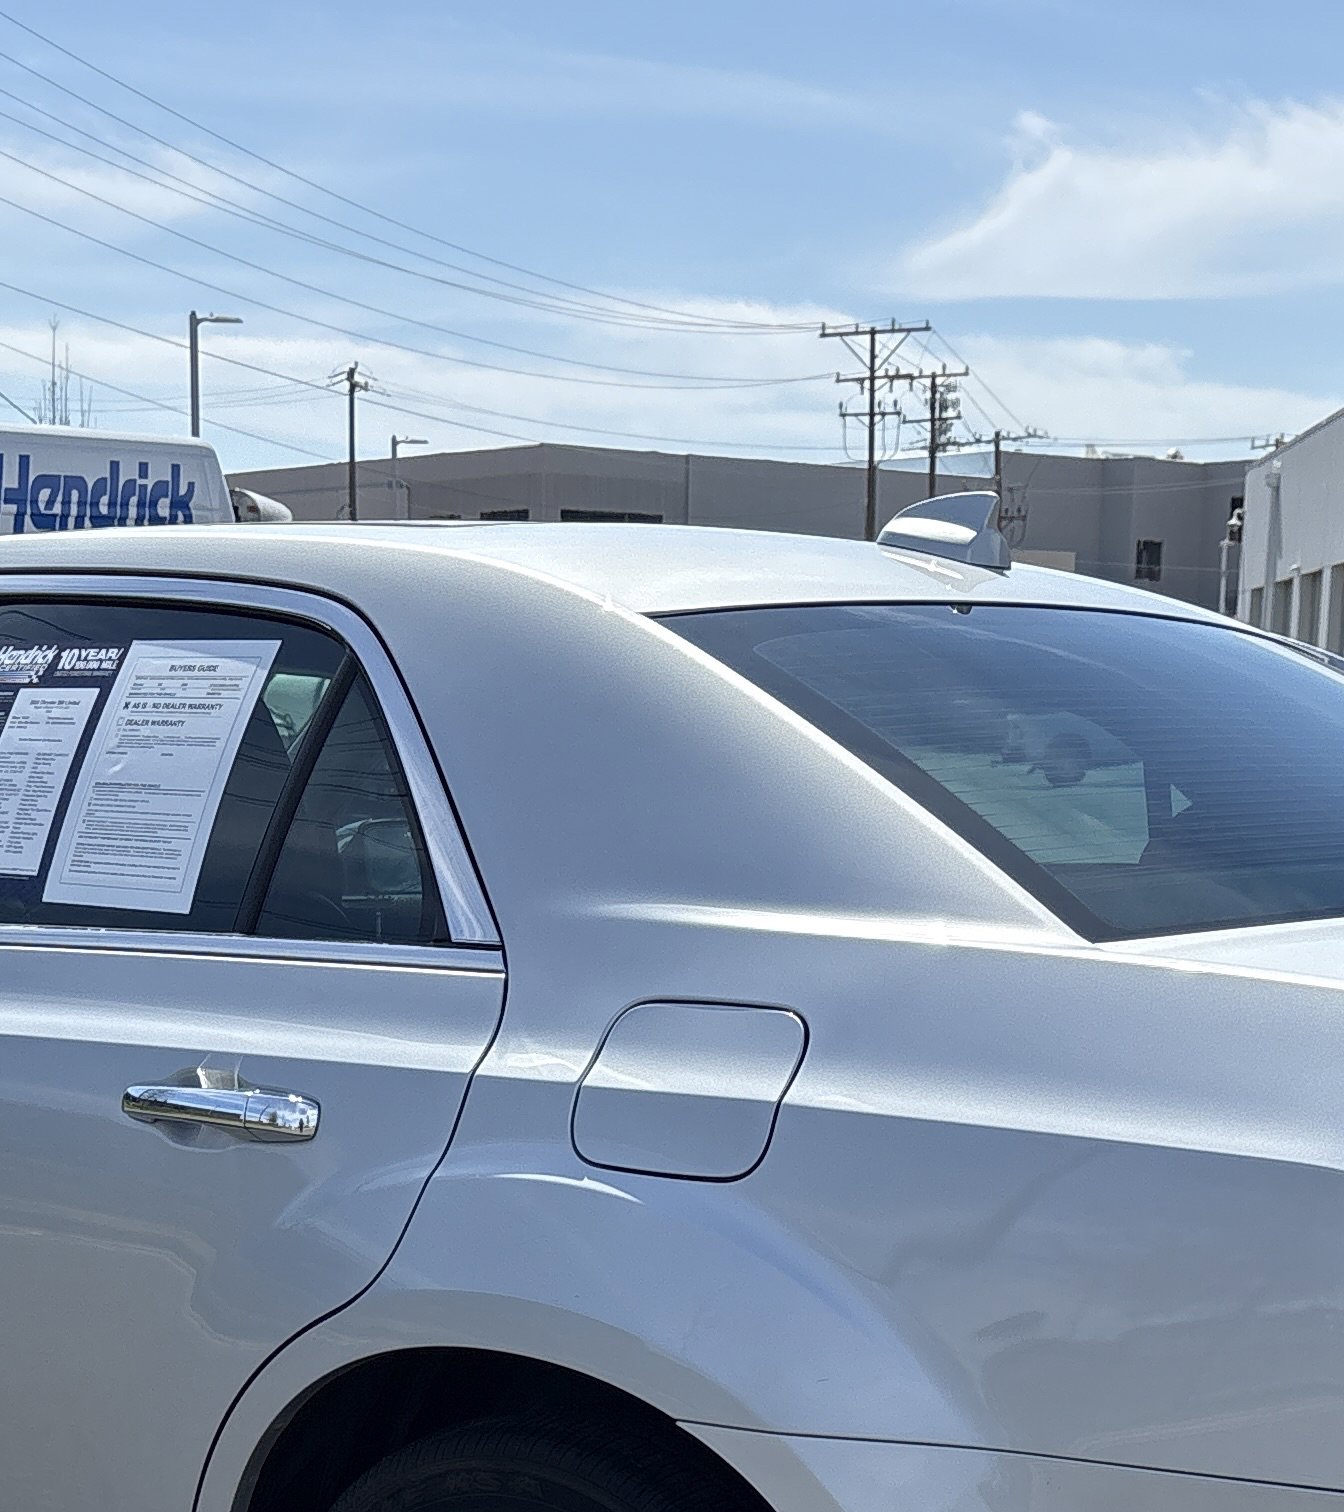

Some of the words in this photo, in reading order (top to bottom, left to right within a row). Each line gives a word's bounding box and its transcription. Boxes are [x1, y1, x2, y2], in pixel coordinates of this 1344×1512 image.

[57, 648, 80, 670] 10
[168, 664, 197, 673] BUYERS
[198, 664, 220, 673] GUIDE
[187, 703, 224, 711] WARRANTY
[124, 718, 149, 727] DEALER
[150, 719, 186, 728] WARRANTY
